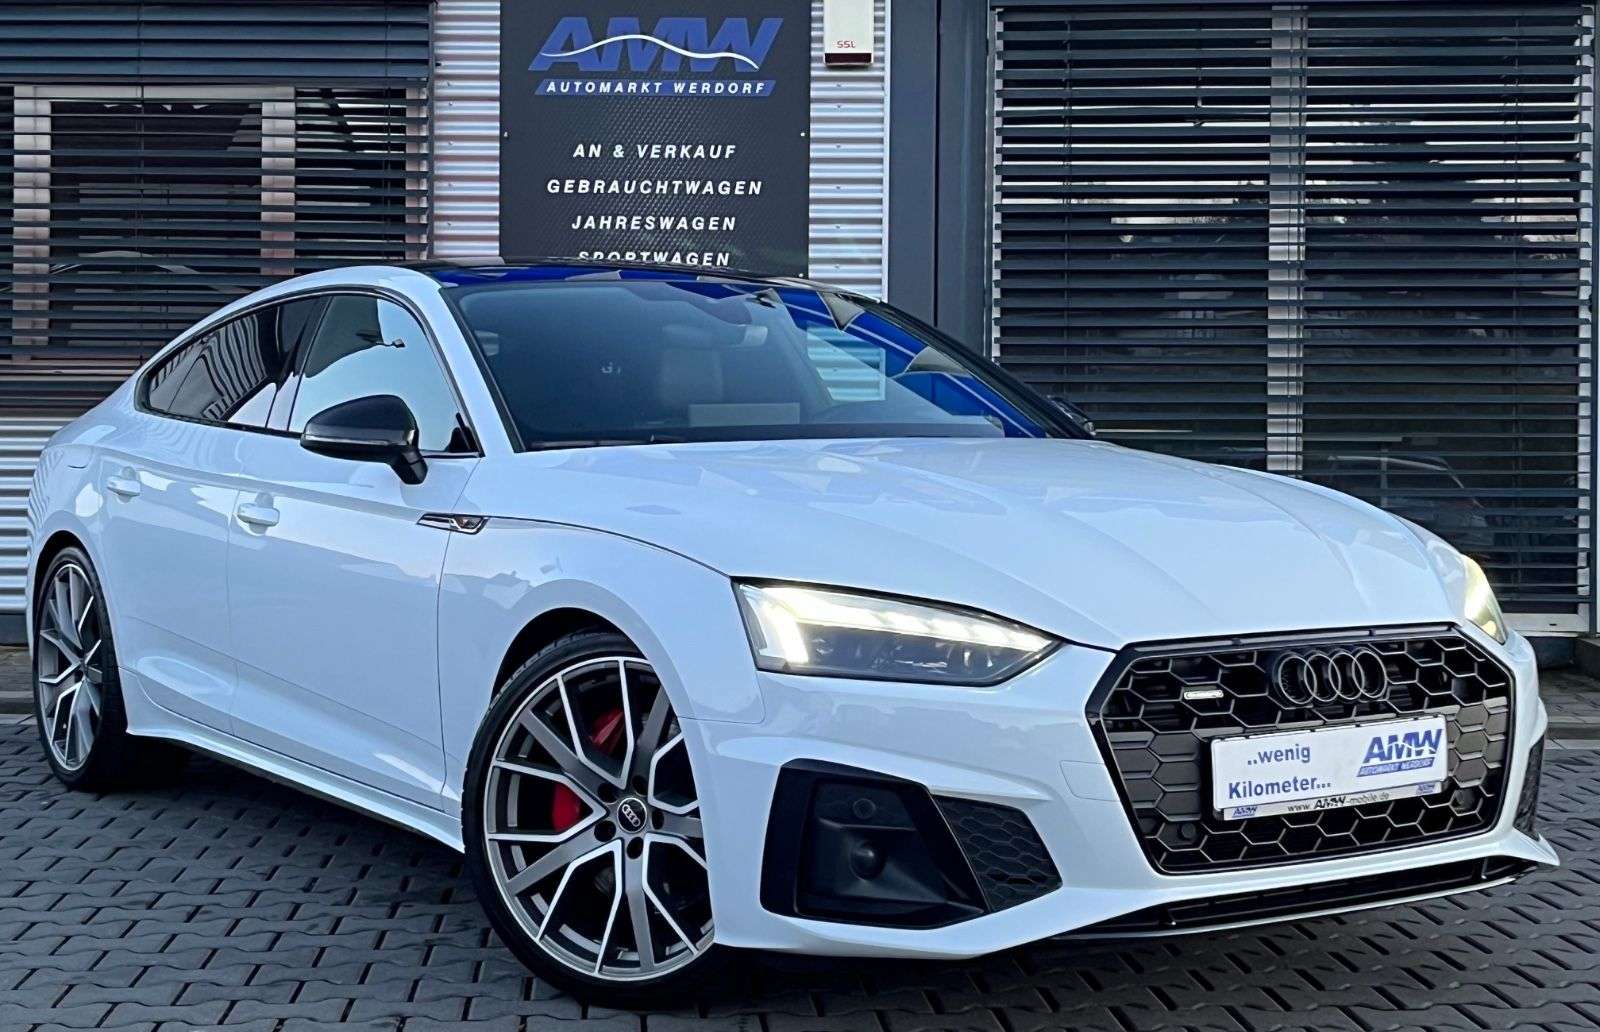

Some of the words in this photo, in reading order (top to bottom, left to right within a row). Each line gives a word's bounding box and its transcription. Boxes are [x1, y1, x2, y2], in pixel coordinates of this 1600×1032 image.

[528, 17, 783, 72] AMW
[546, 81, 662, 94] AUTOMARKT
[673, 82, 766, 95] WERDORF
[573, 144, 602, 158] AN
[613, 144, 625, 158] &
[637, 144, 737, 159] VERKAUF
[547, 179, 762, 195] GEBRAUCHTWAGEN
[572, 215, 737, 231] JAHRESWAGEN
[1362, 728, 1443, 764] AMW
[1228, 775, 1331, 799] Kilometer...
